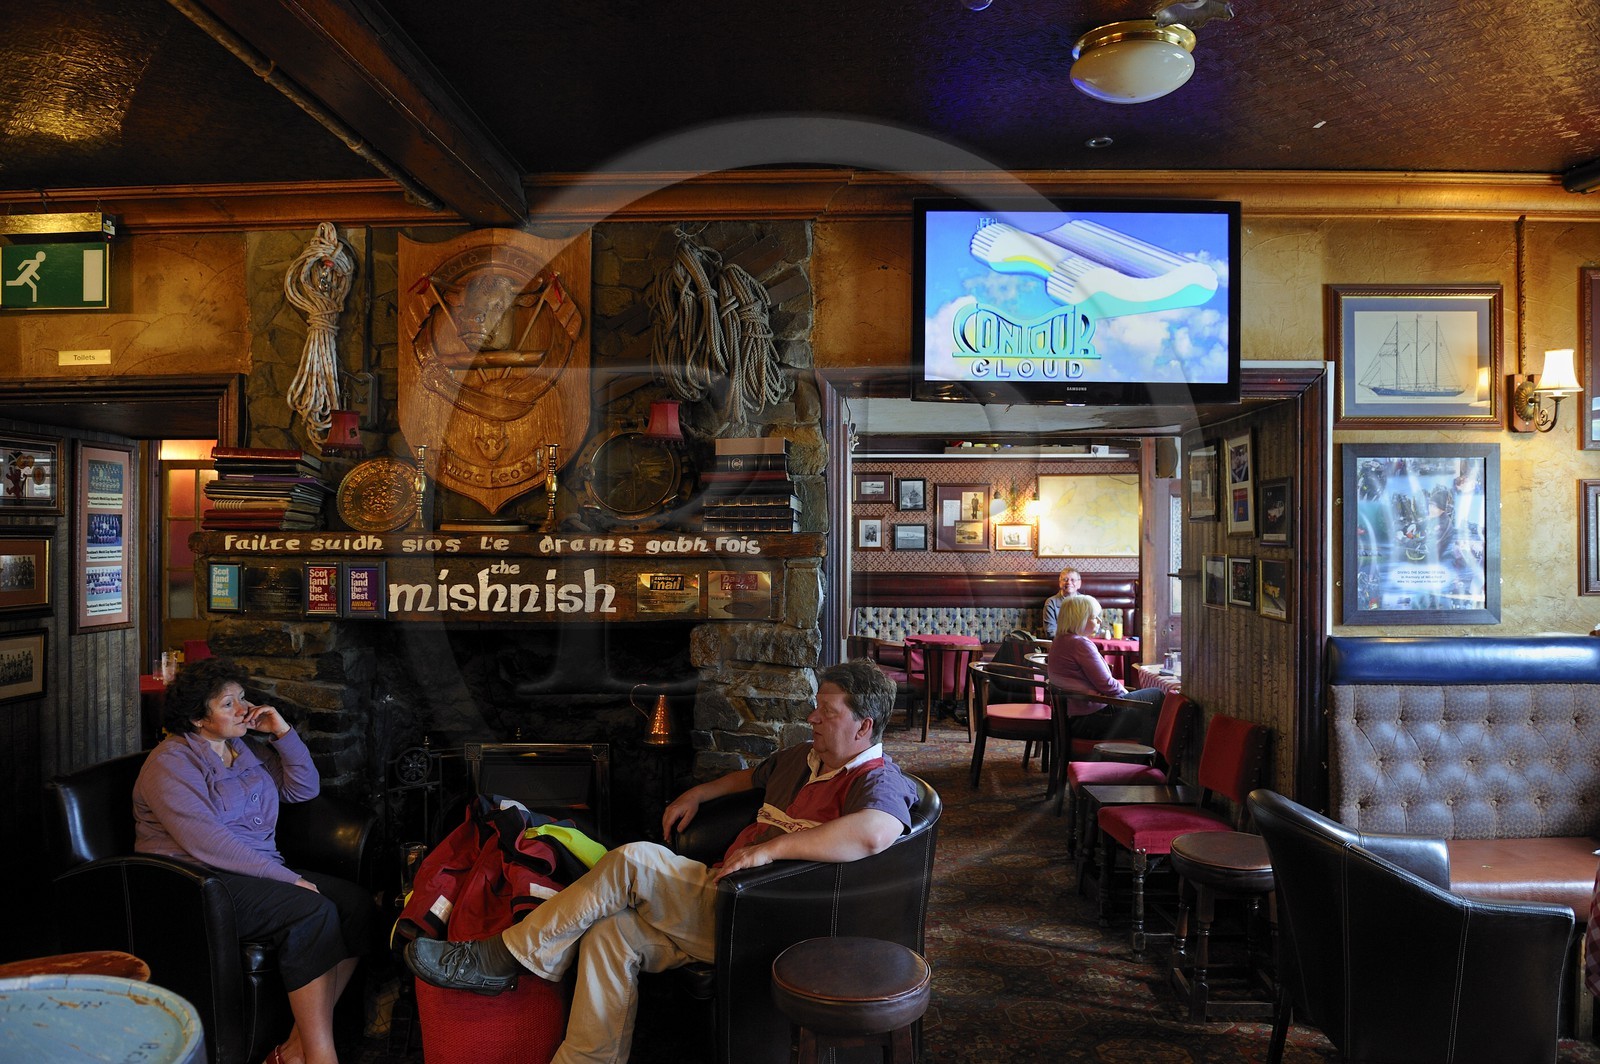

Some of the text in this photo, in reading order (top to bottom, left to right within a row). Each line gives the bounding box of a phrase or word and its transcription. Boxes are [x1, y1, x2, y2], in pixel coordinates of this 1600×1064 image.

[952, 302, 1096, 355] CONTOUR
[971, 358, 1084, 378] CLOUD
[310, 534, 384, 551] suidh
[402, 536, 461, 552] sios
[538, 535, 635, 553] drams
[645, 536, 710, 554] gabh
[715, 535, 761, 555] Fois
[309, 568, 328, 577] Scot
[490, 560, 521, 575] the
[351, 571, 368, 579] Scot
[309, 577, 328, 586] land
[351, 578, 368, 586] land
[653, 577, 682, 590] mail
[309, 585, 322, 593] the
[387, 568, 617, 613] mishnish
[309, 592, 328, 602] best
[351, 592, 368, 600] Best
